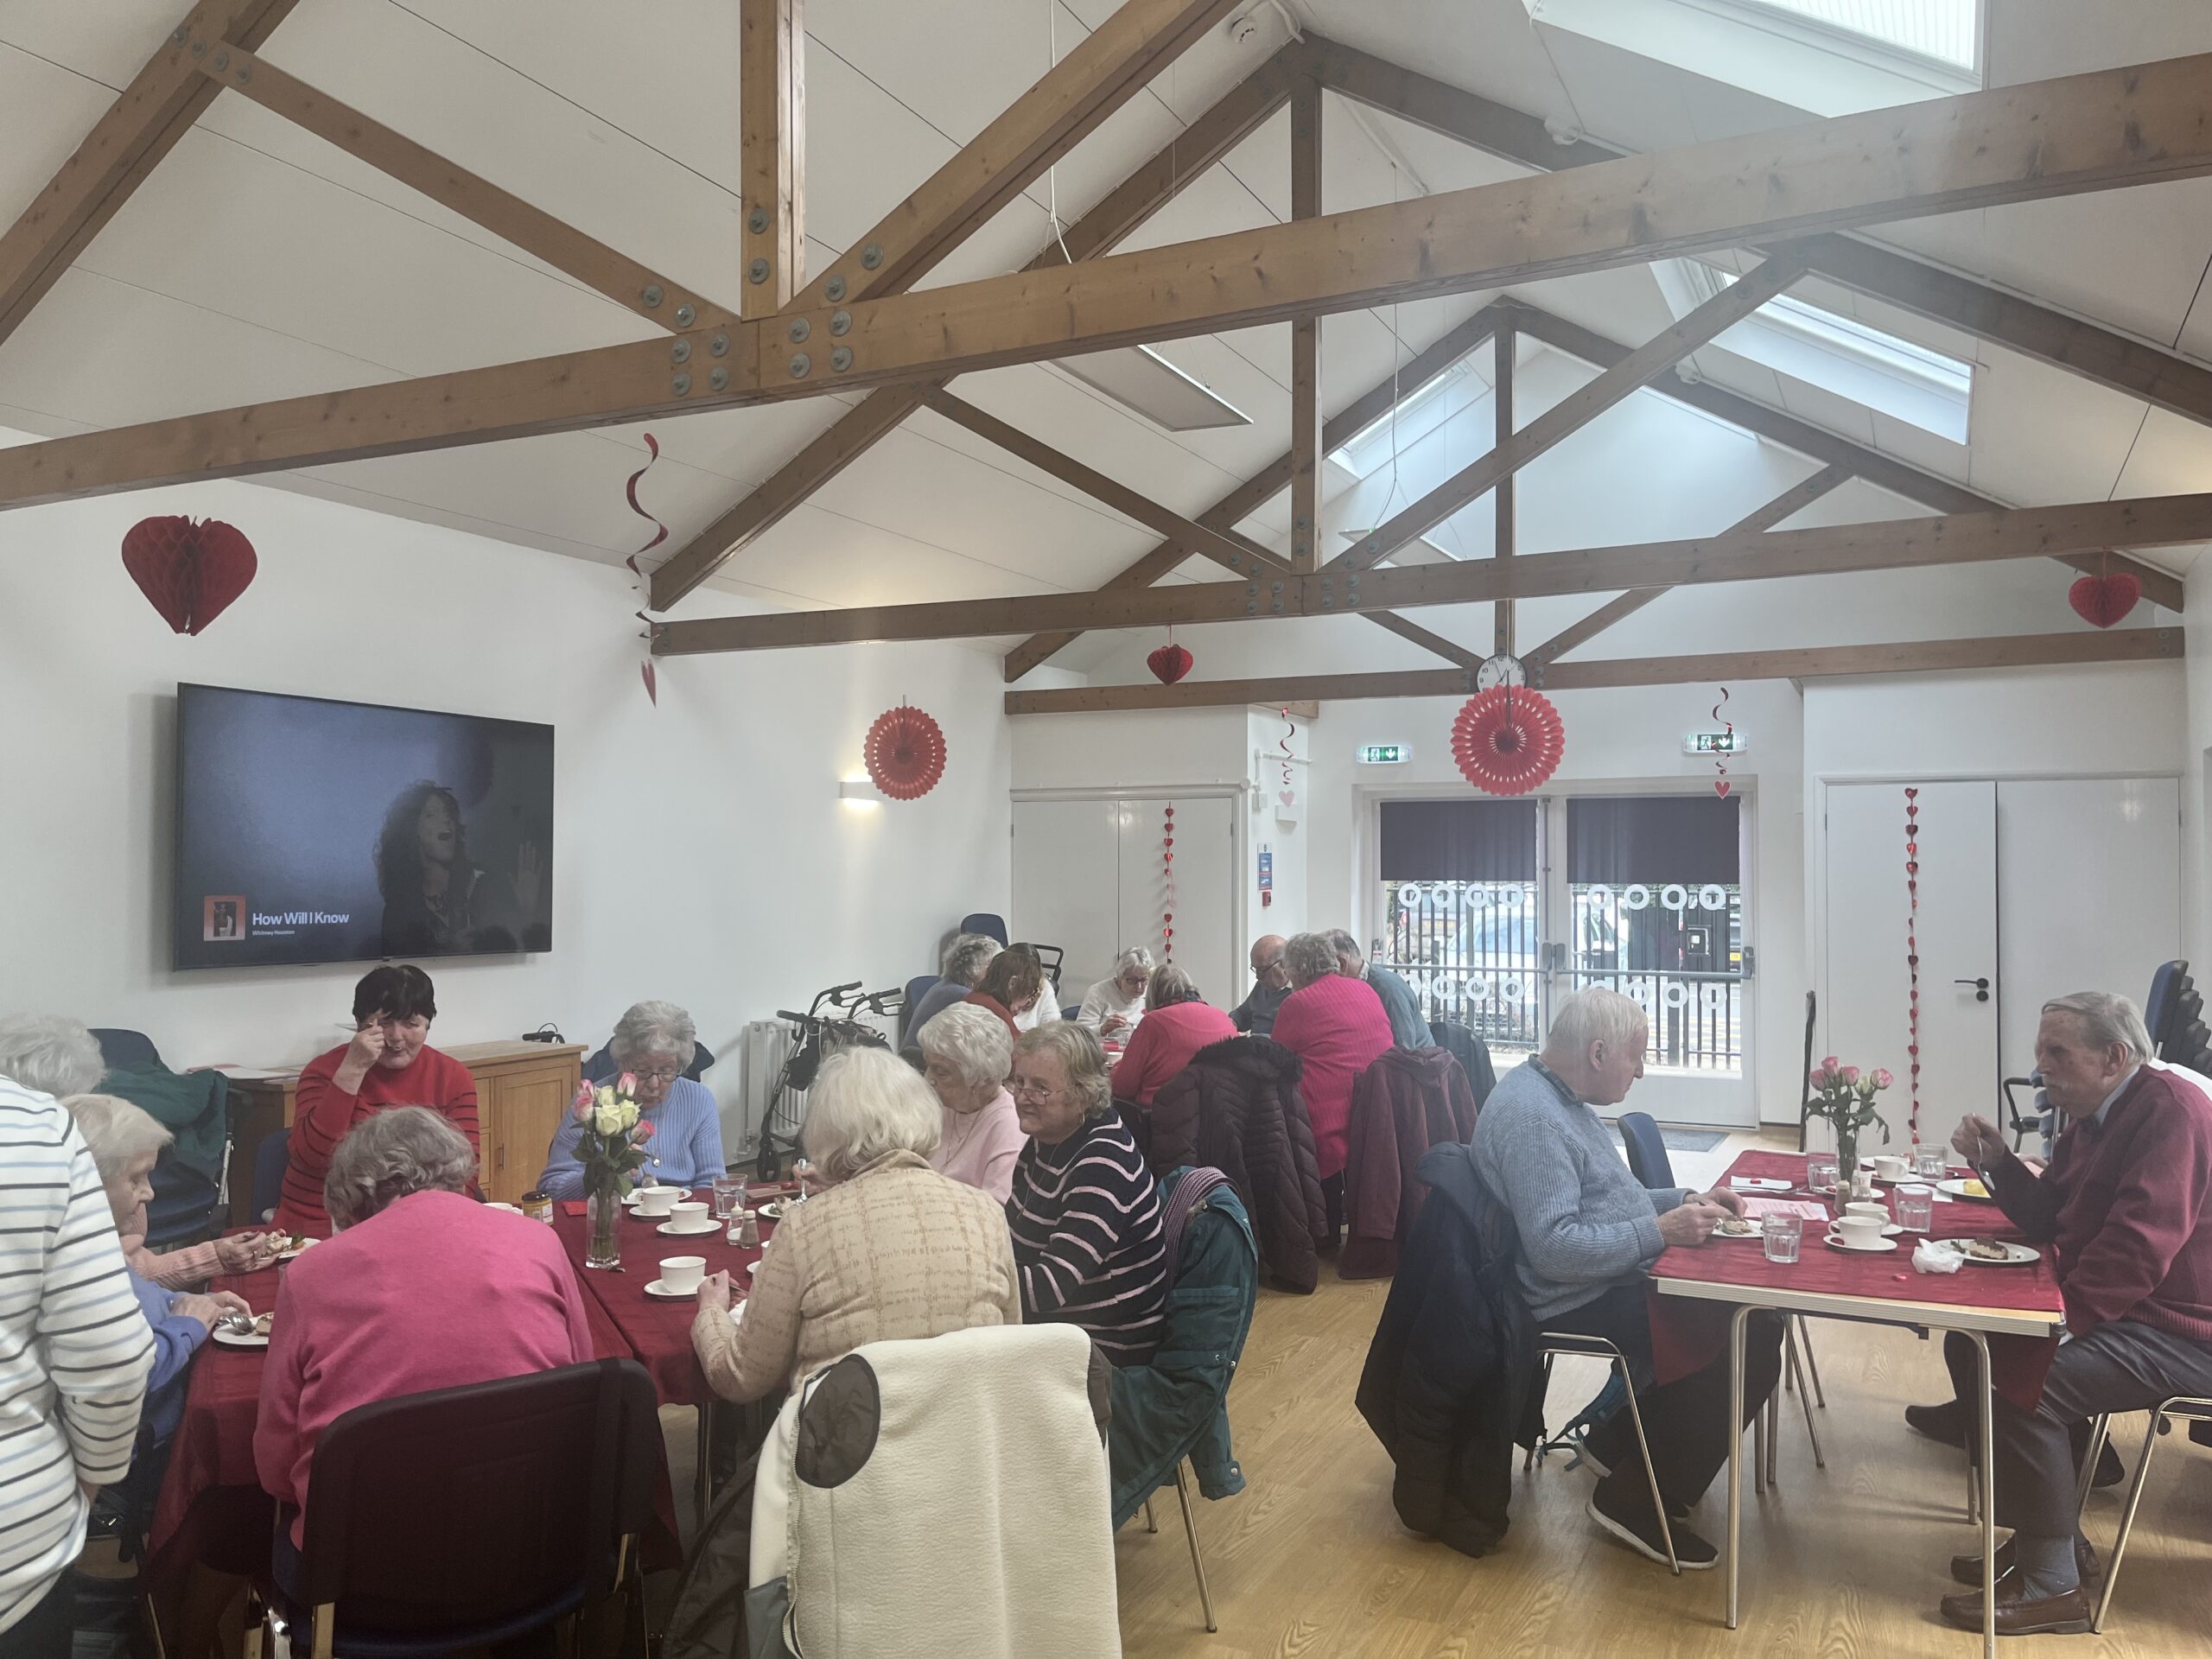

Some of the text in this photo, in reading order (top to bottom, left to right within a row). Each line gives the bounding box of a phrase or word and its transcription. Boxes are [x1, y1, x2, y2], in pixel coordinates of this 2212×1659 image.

[253, 912, 283, 925] How
[284, 912, 308, 925] Will
[315, 912, 349, 924] Know
